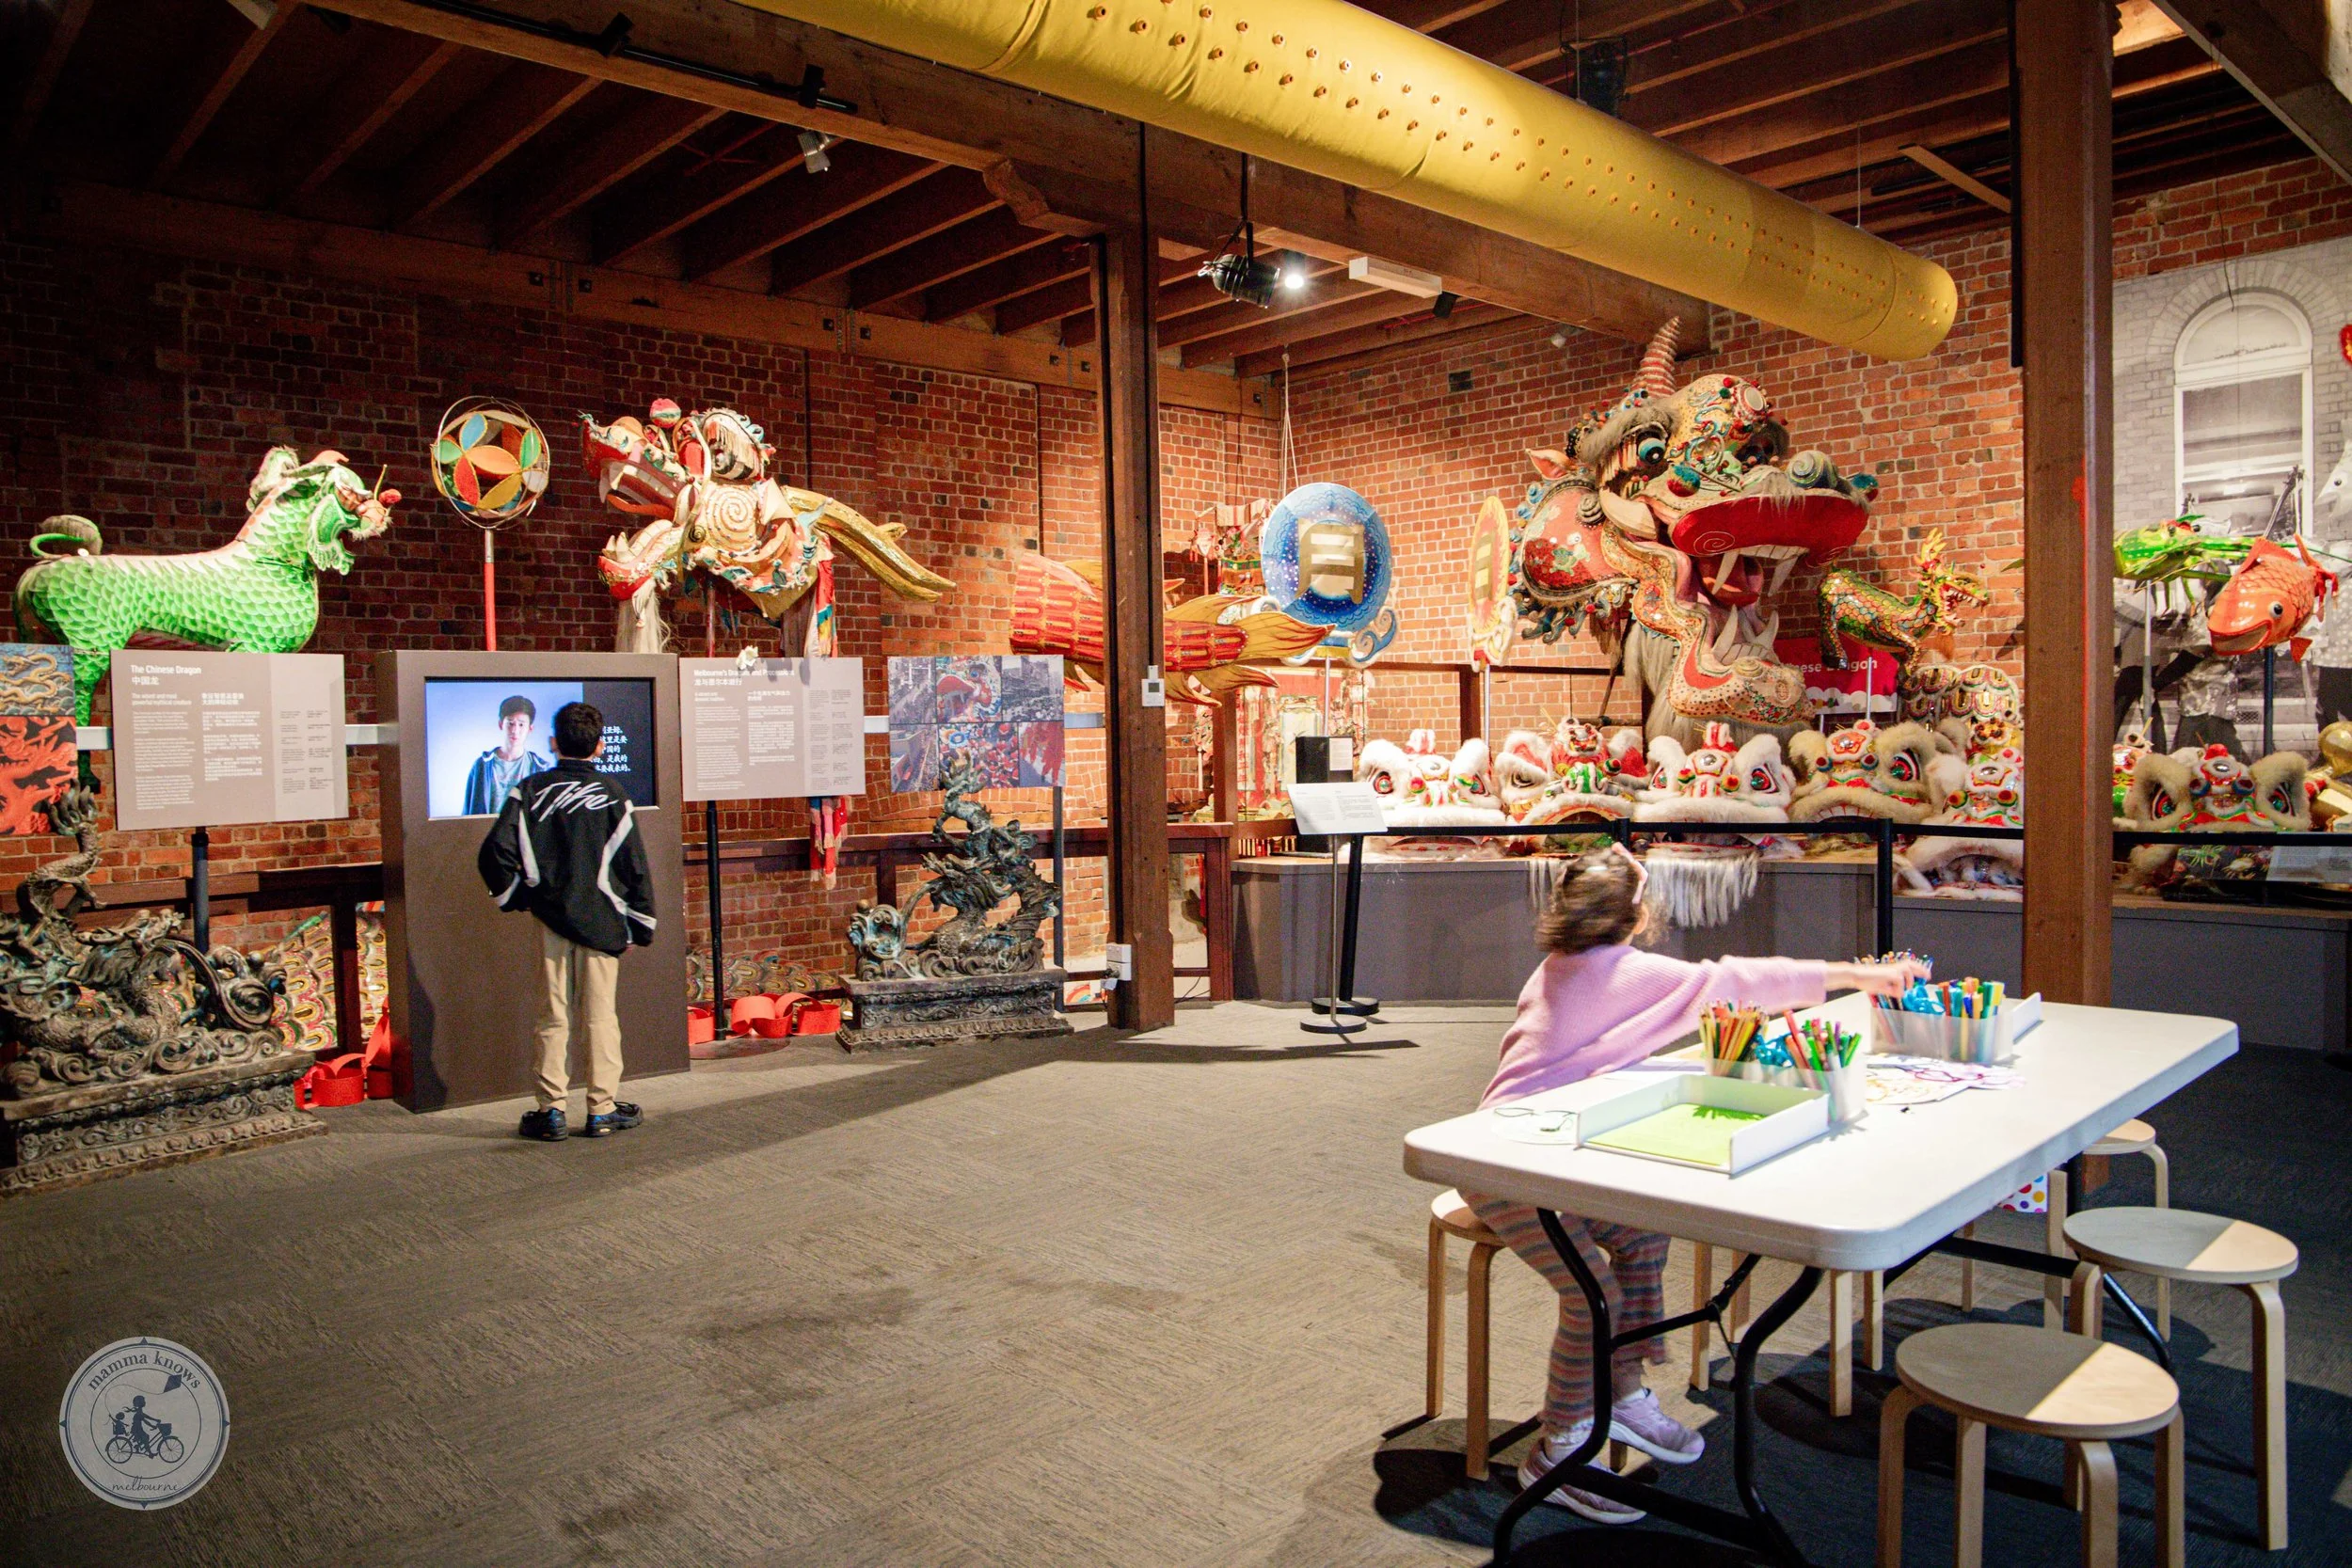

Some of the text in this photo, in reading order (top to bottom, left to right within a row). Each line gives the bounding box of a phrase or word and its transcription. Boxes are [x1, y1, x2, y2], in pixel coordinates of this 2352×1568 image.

[1295, 517, 1365, 605] 月
[131, 665, 202, 675] The Chinese Dragon
[132, 676, 159, 686] 中国龙
[531, 781, 619, 822] Nike
